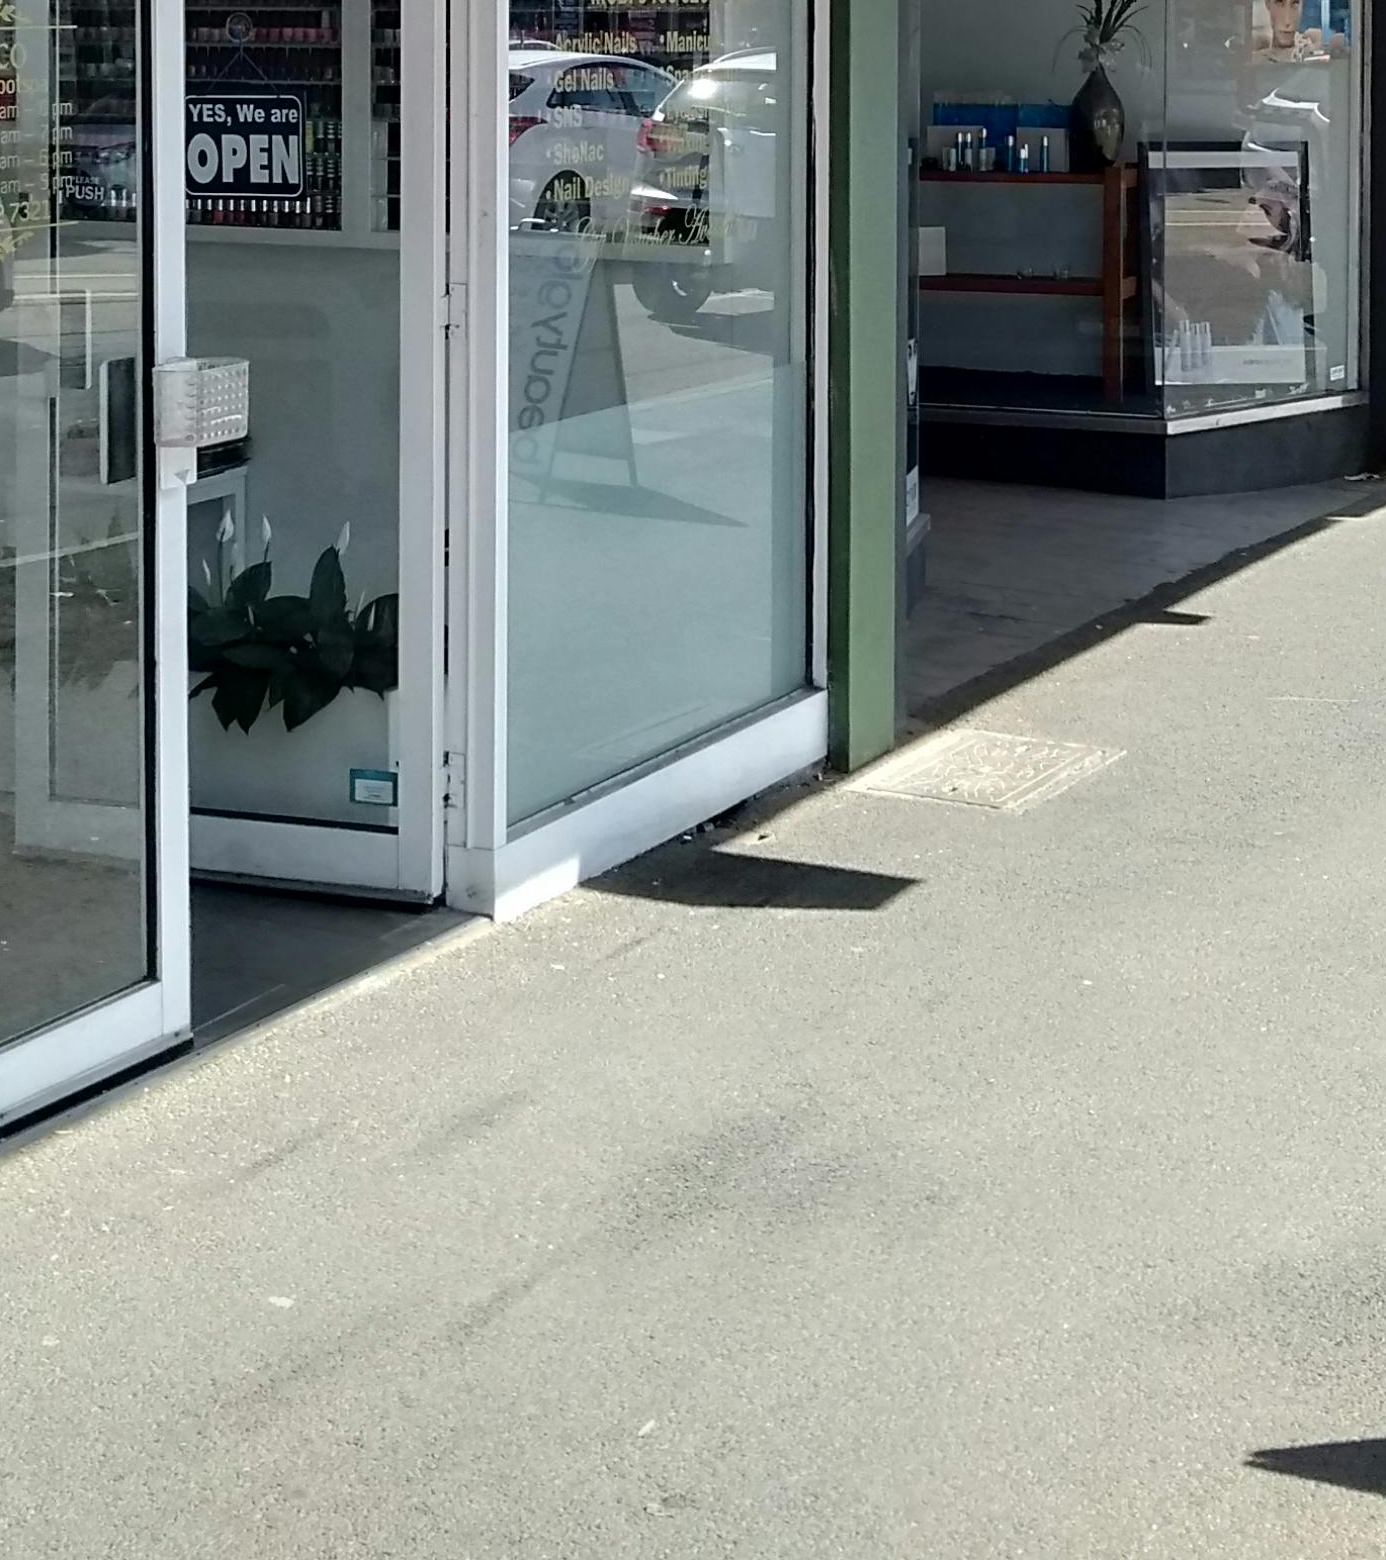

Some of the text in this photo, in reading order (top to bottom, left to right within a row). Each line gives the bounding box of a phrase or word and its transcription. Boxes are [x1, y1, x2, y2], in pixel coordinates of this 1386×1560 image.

[556, 31, 637, 53] Acrylic Nails
[554, 69, 614, 92] Gel Nails
[188, 103, 298, 126] YES, We are
[187, 133, 299, 184] OPEN
[65, 185, 104, 201] PUSH
[554, 178, 581, 200] Nail
